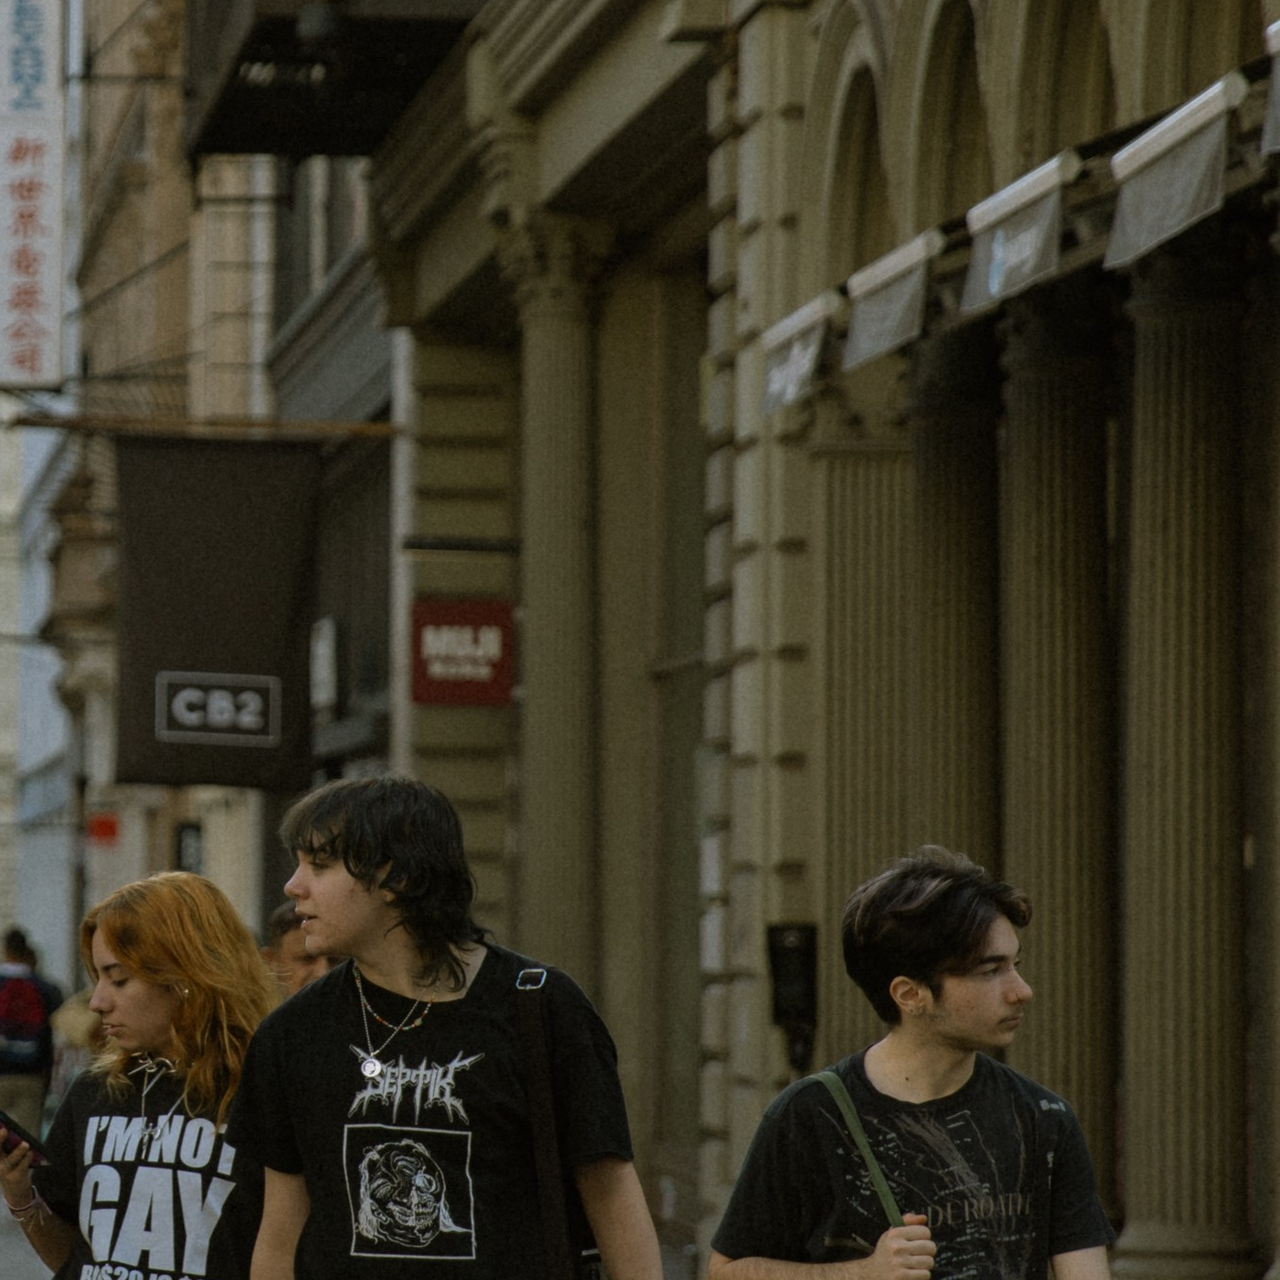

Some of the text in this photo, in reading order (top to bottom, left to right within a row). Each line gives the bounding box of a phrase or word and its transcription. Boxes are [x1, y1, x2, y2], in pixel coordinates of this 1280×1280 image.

[171, 687, 265, 731] CB2
[83, 1115, 148, 1166] I'M
[78, 1163, 237, 1277] GAY
